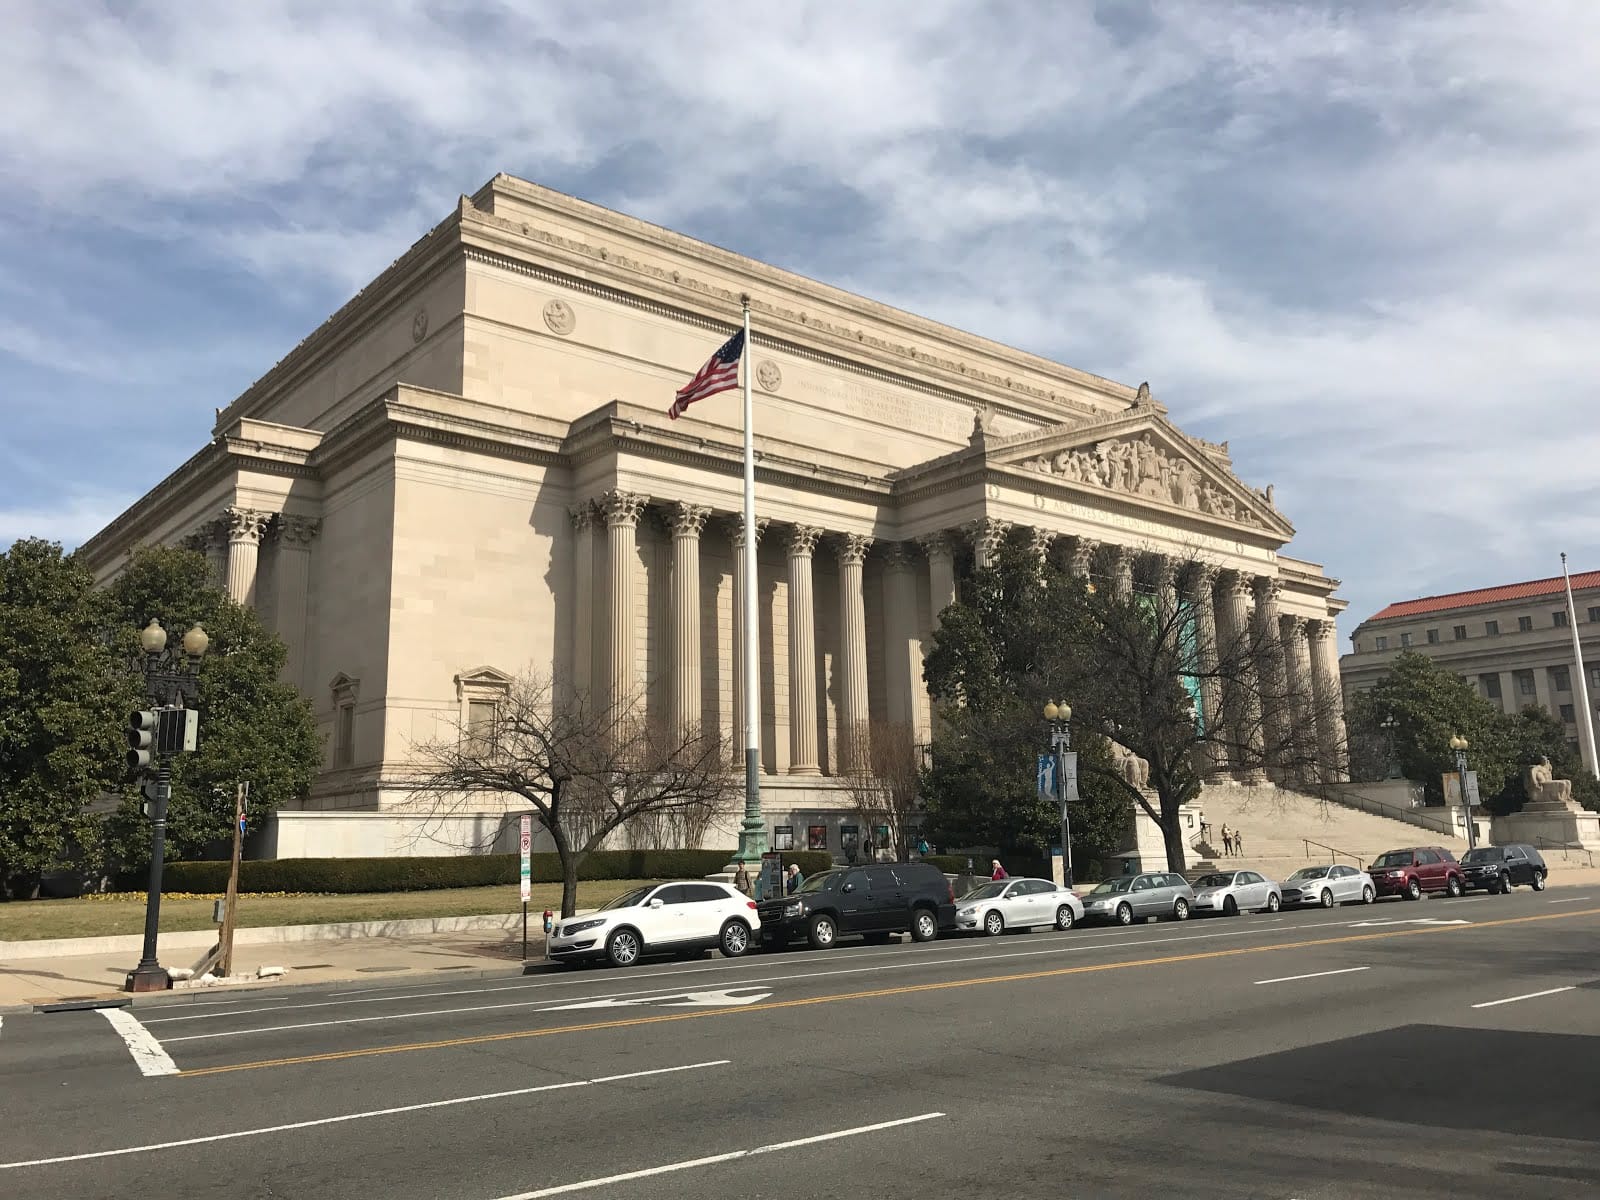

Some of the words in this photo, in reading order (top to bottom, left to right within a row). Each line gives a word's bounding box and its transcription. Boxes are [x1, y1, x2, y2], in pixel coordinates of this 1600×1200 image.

[1054, 502, 1097, 520] ARCHIVES
[1098, 510, 1109, 522] OF
[1112, 514, 1125, 527] THE
